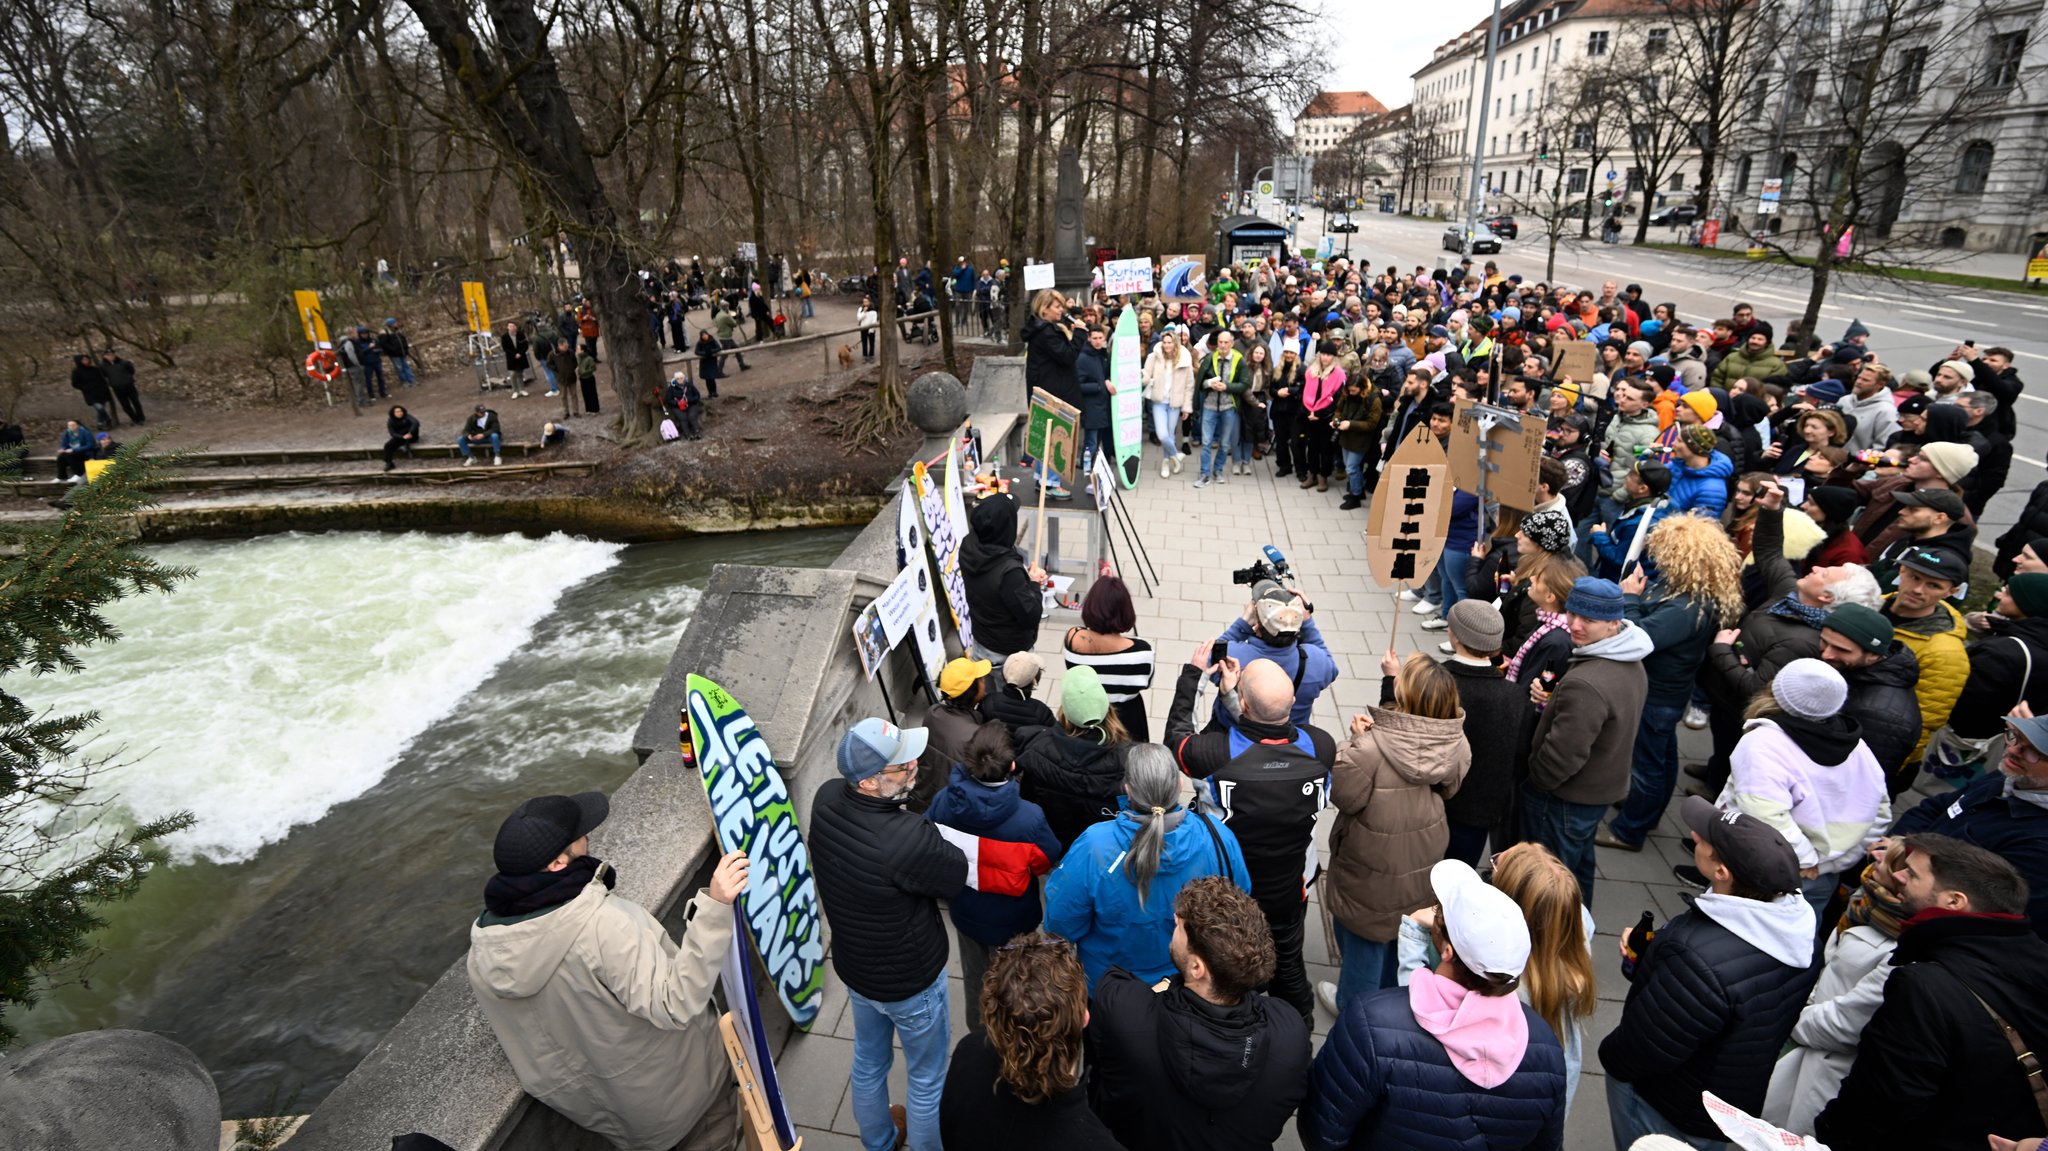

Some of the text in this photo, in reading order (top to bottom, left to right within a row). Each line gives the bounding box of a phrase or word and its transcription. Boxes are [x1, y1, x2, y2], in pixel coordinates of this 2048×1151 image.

[1107, 261, 1151, 281] Surfing
[1107, 281, 1142, 293] CRIME
[690, 692, 754, 854] THE
[723, 715, 787, 808] LET
[769, 816, 807, 886] US
